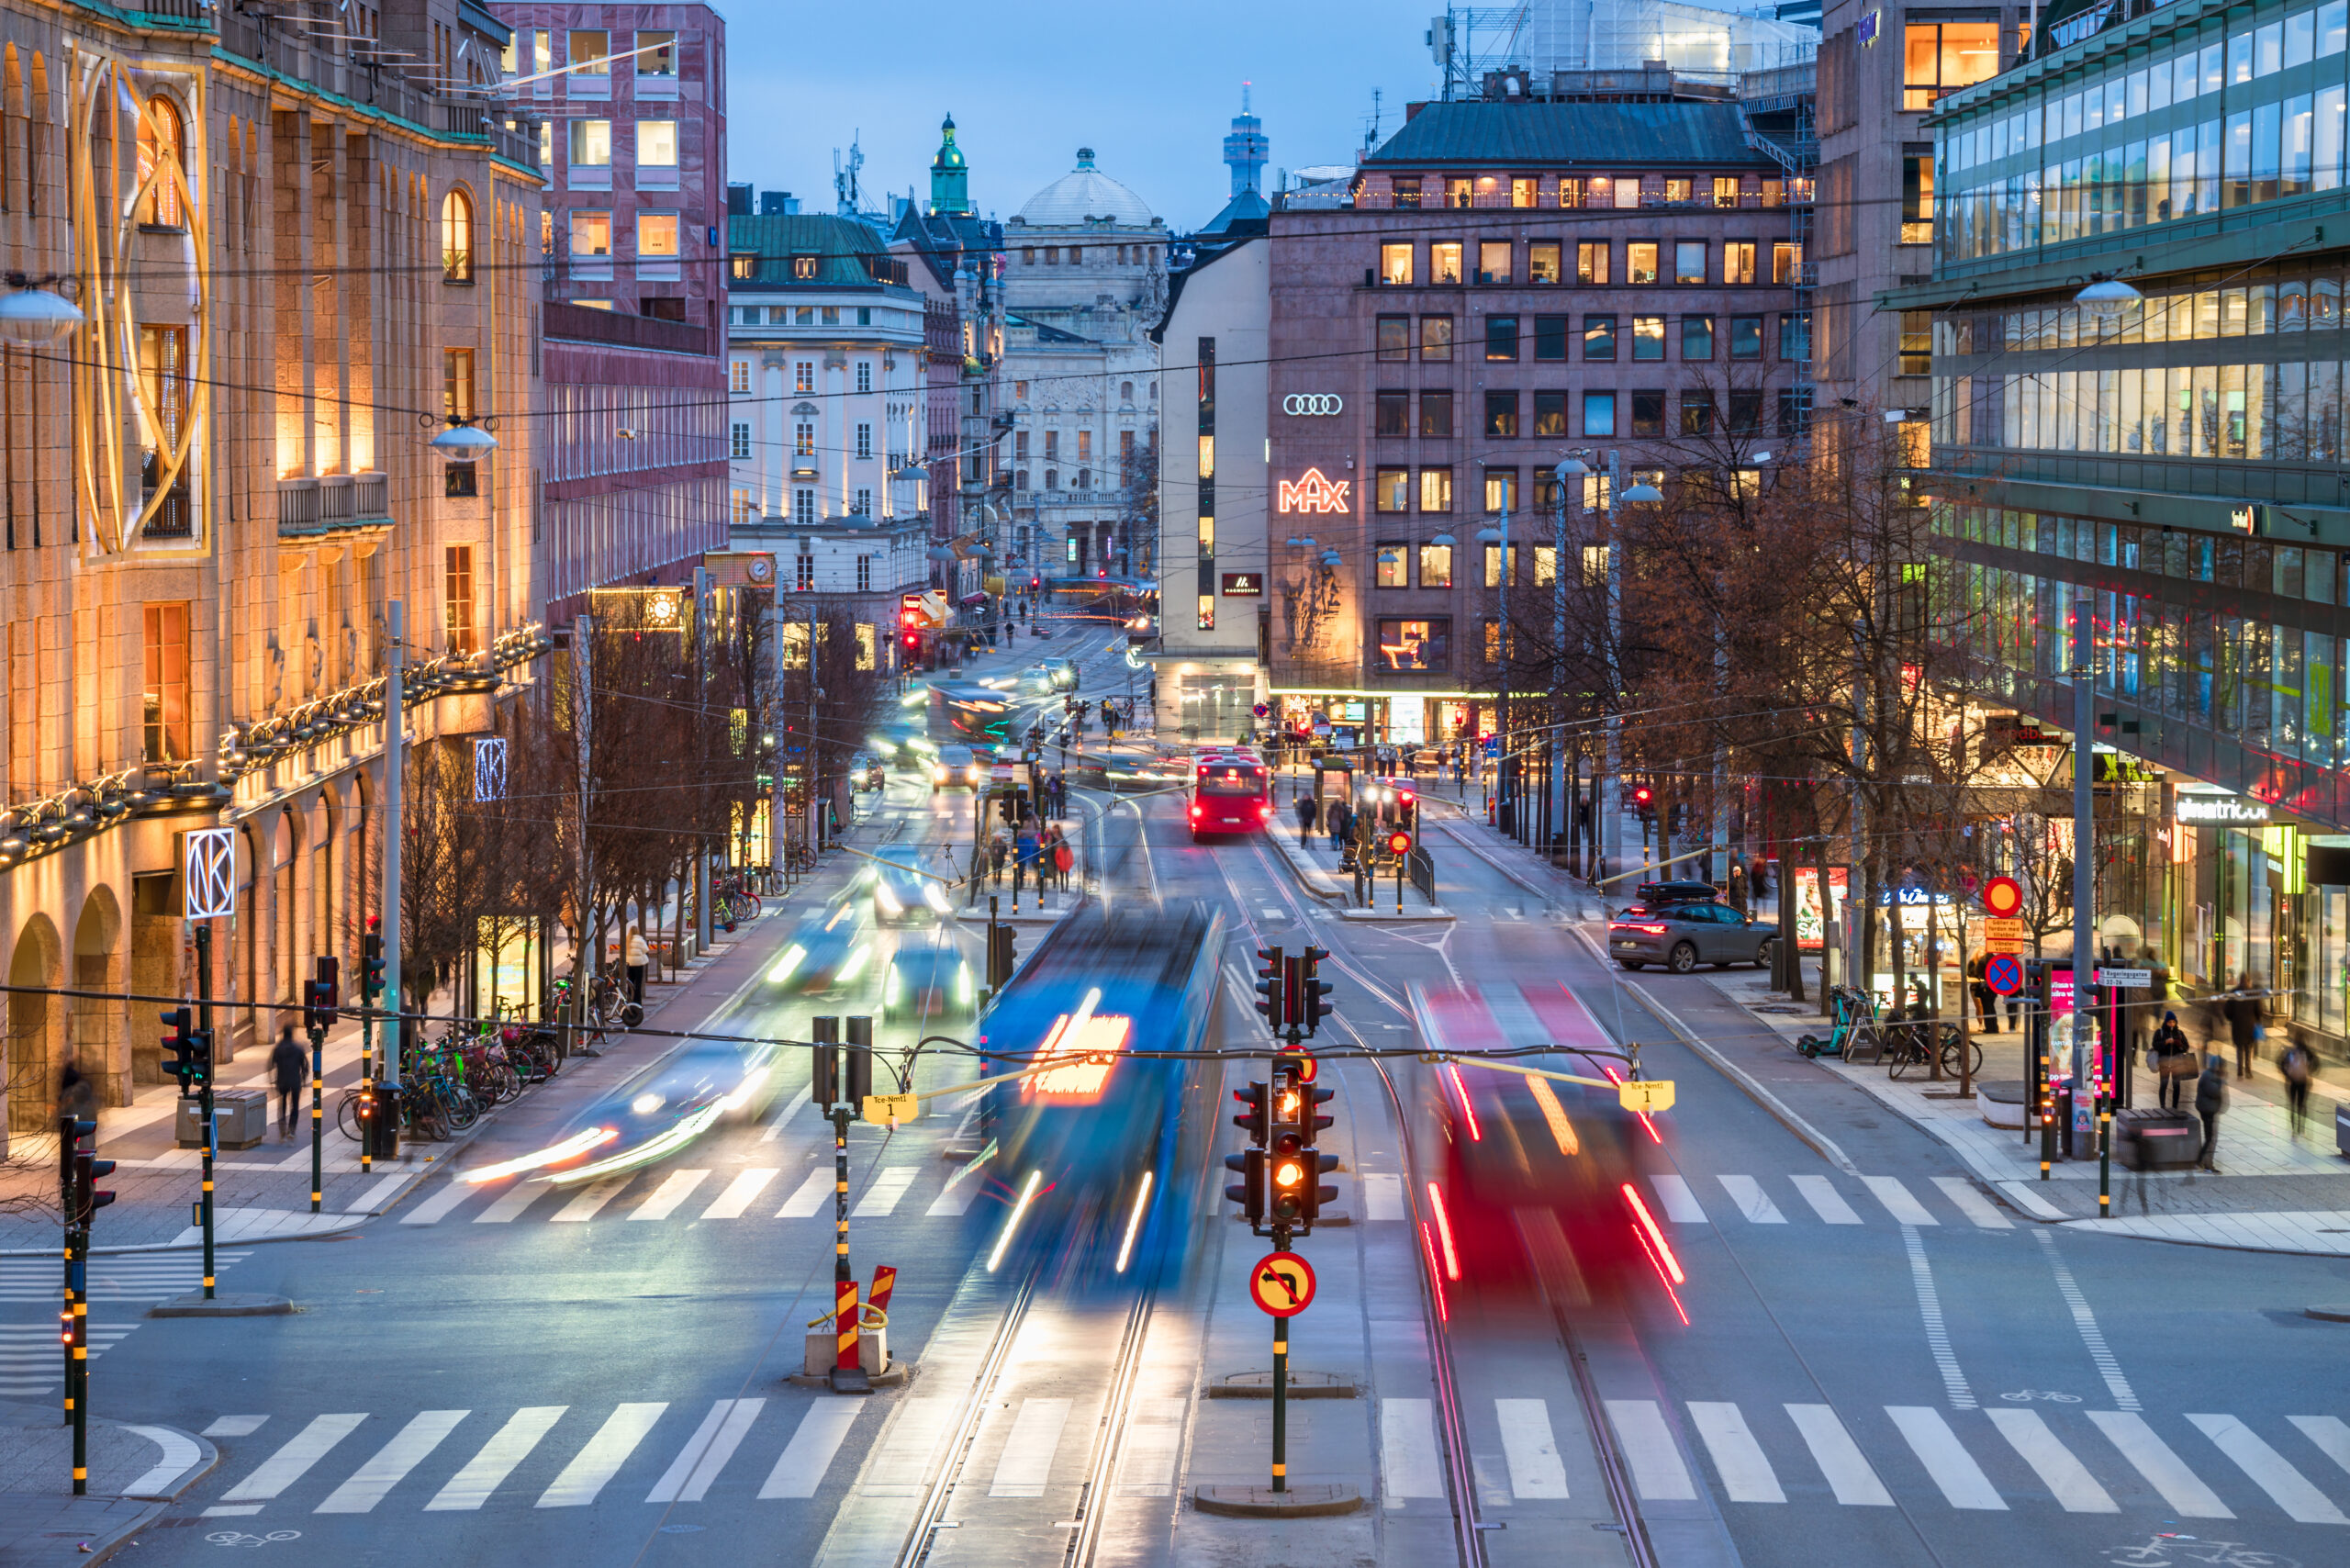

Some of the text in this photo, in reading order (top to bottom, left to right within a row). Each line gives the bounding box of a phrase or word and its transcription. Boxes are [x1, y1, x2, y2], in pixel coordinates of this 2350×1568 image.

[1279, 466, 1350, 513] MAX
[1644, 1091, 1651, 1103] 1
[887, 1103, 895, 1116] 1
